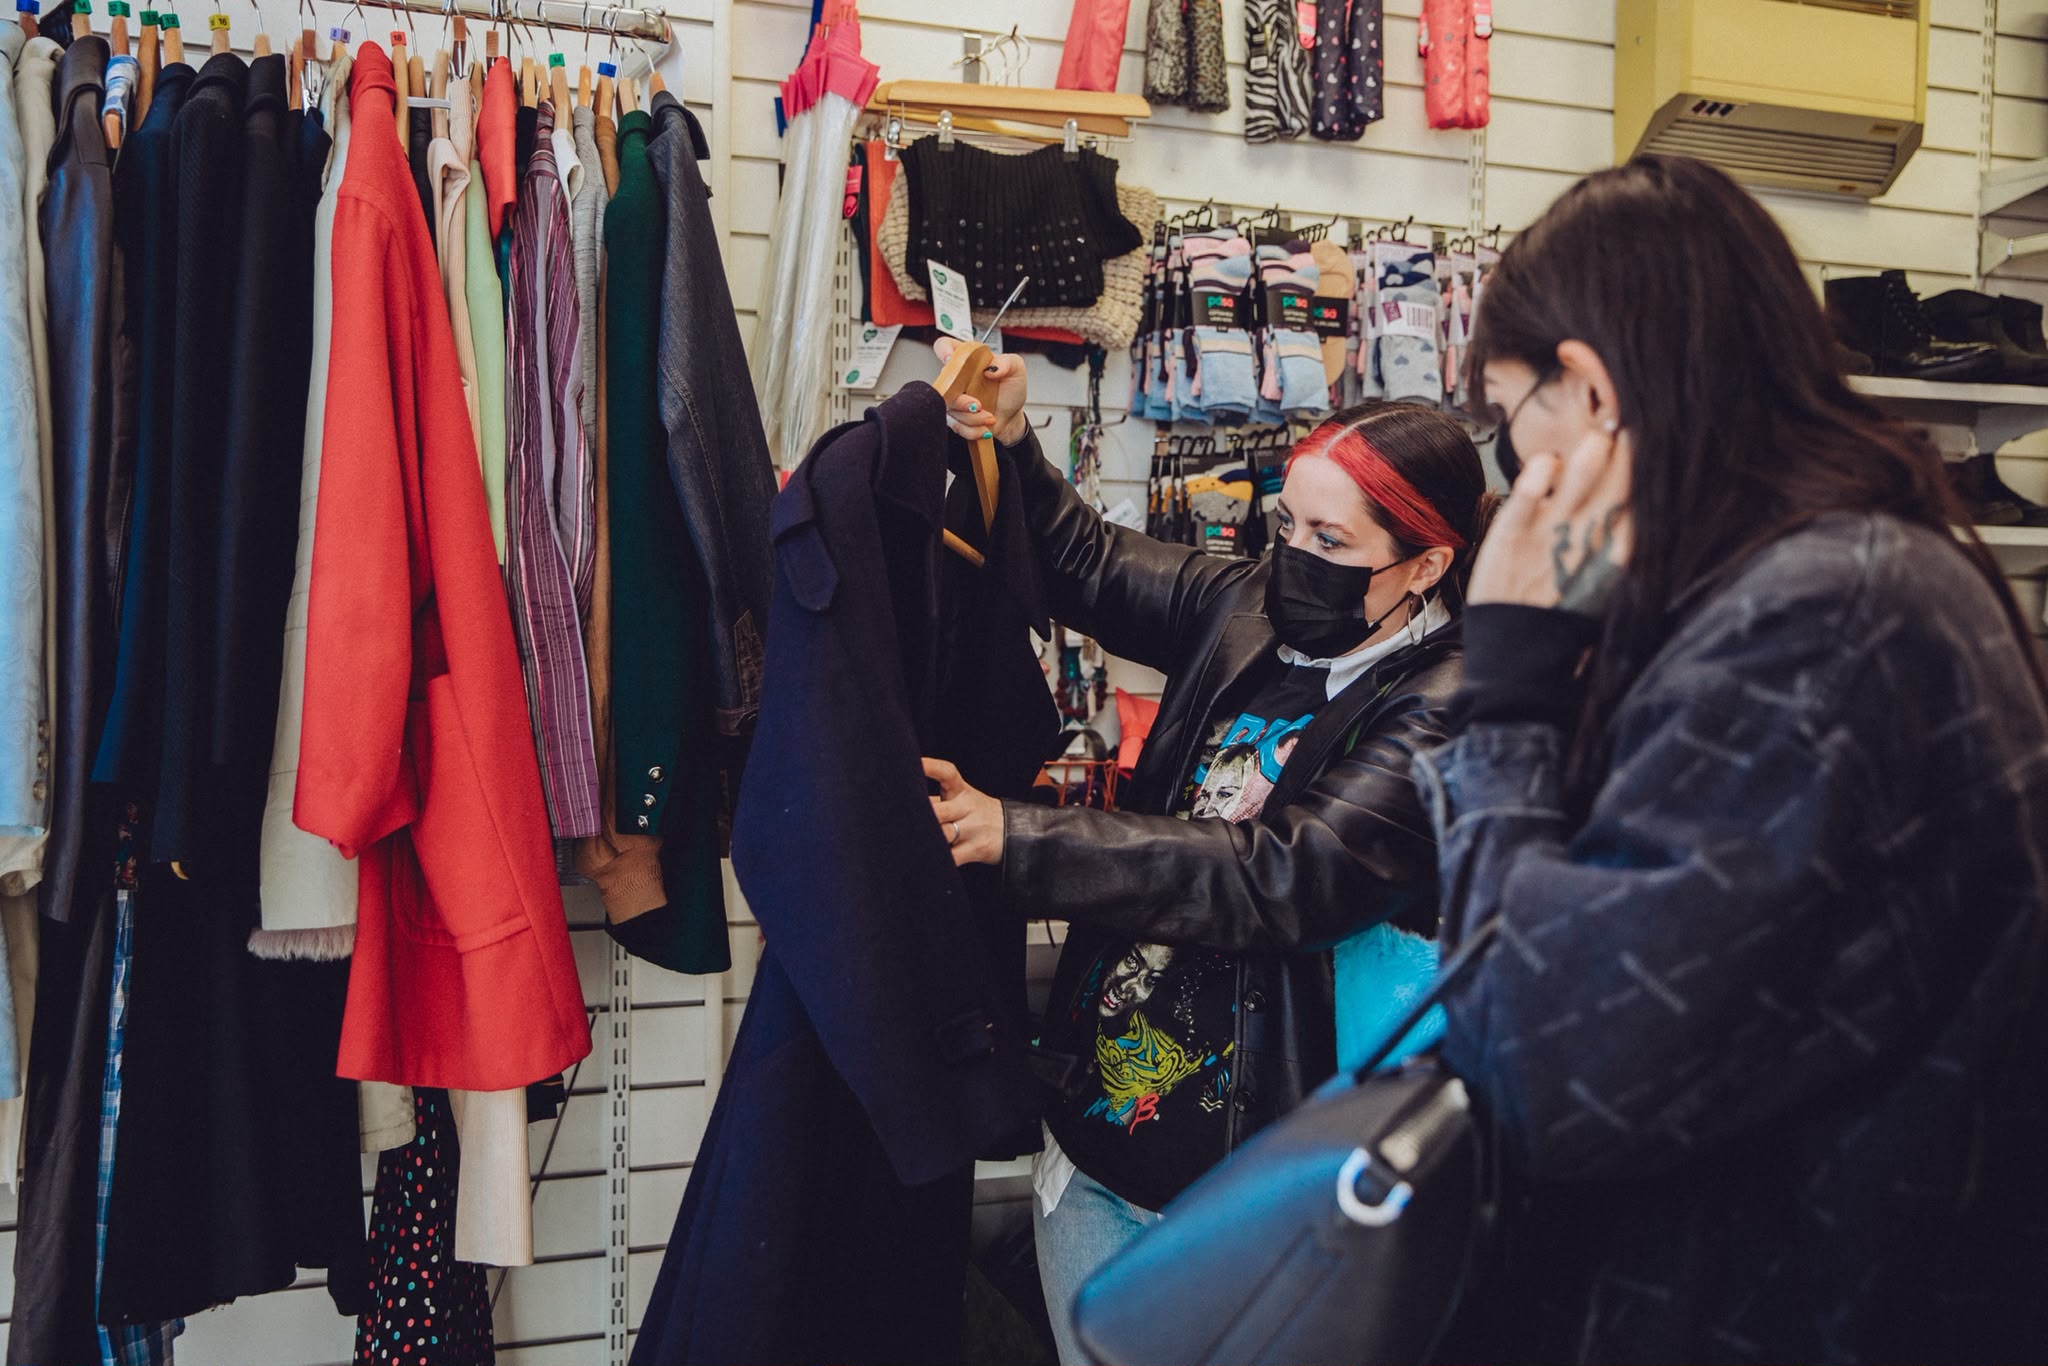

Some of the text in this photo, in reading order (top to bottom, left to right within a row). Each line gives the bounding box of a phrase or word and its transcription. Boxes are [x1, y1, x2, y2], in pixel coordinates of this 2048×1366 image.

[165, 16, 177, 25] 12
[218, 18, 228, 26] 16
[1207, 295, 1234, 308] pdsa
[1282, 295, 1308, 309] pdsa
[1205, 524, 1236, 538] pdsa
